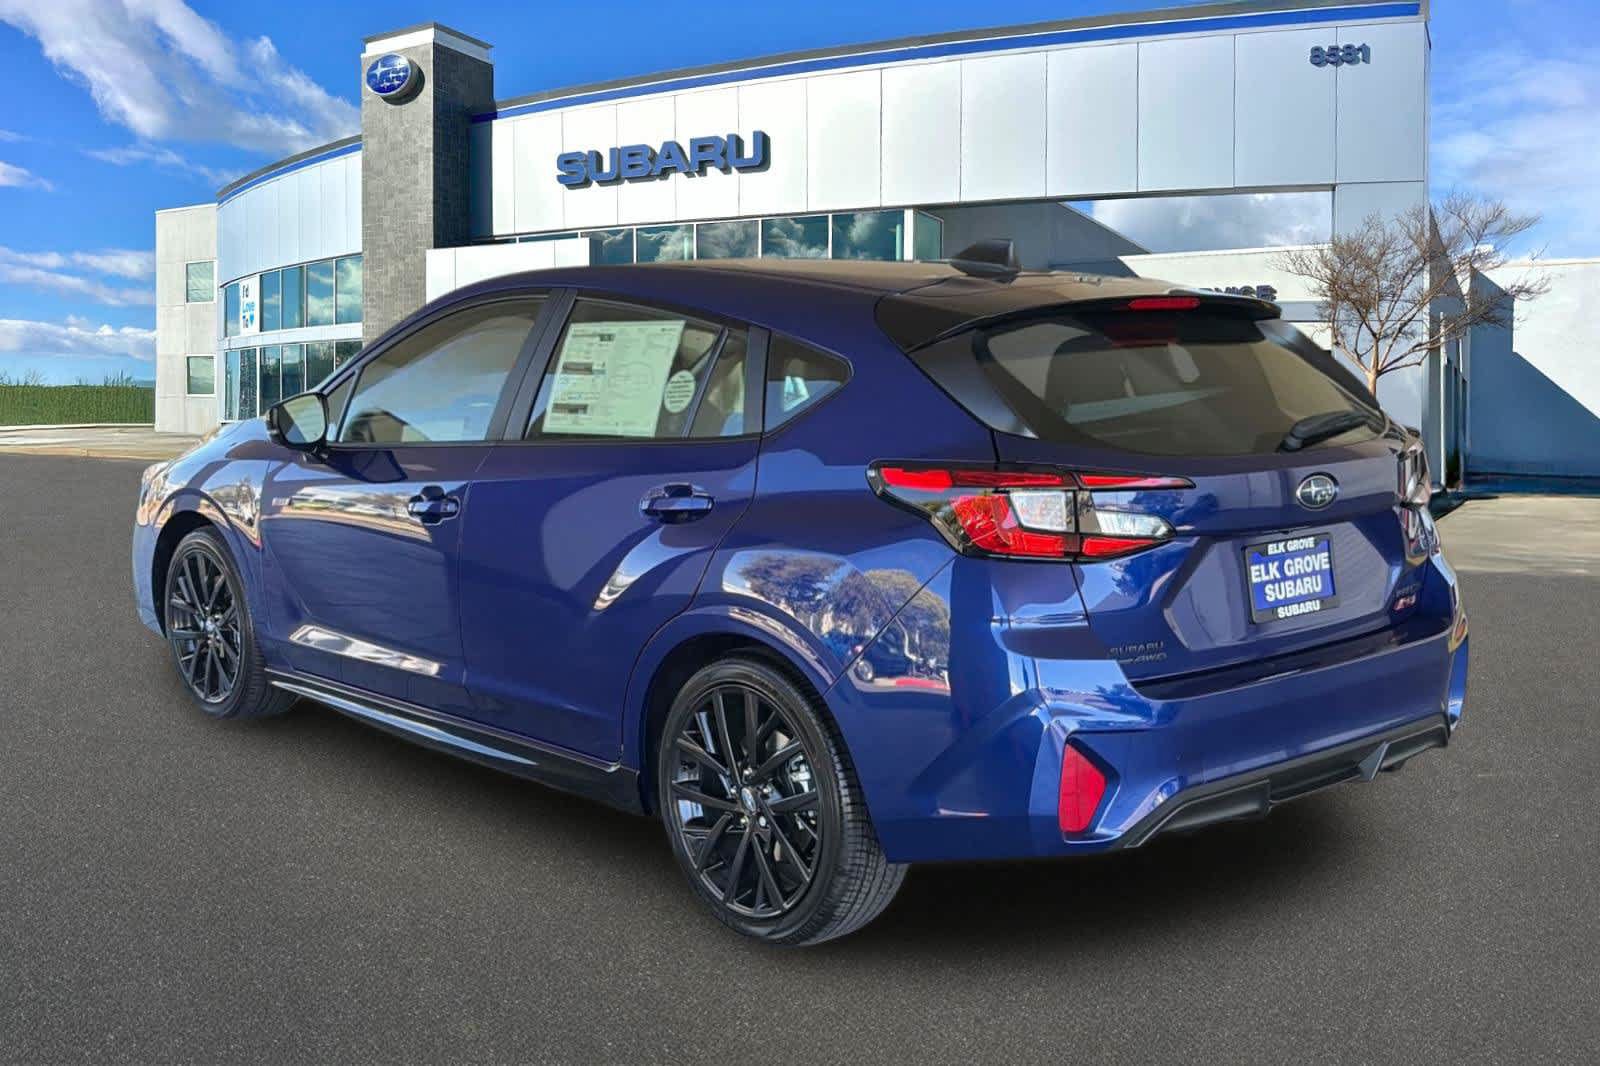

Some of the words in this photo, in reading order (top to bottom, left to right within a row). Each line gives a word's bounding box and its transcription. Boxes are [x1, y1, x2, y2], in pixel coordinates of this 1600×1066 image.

[556, 130, 771, 190] SUBARU
[1268, 542, 1285, 555] ELK
[1287, 537, 1315, 552] GROVE
[1250, 562, 1281, 583] ELK
[1284, 552, 1330, 577] GROVE
[1265, 575, 1322, 602] SUBARU
[1277, 600, 1321, 618] SUBARU
[1108, 641, 1164, 657] SUBARU
